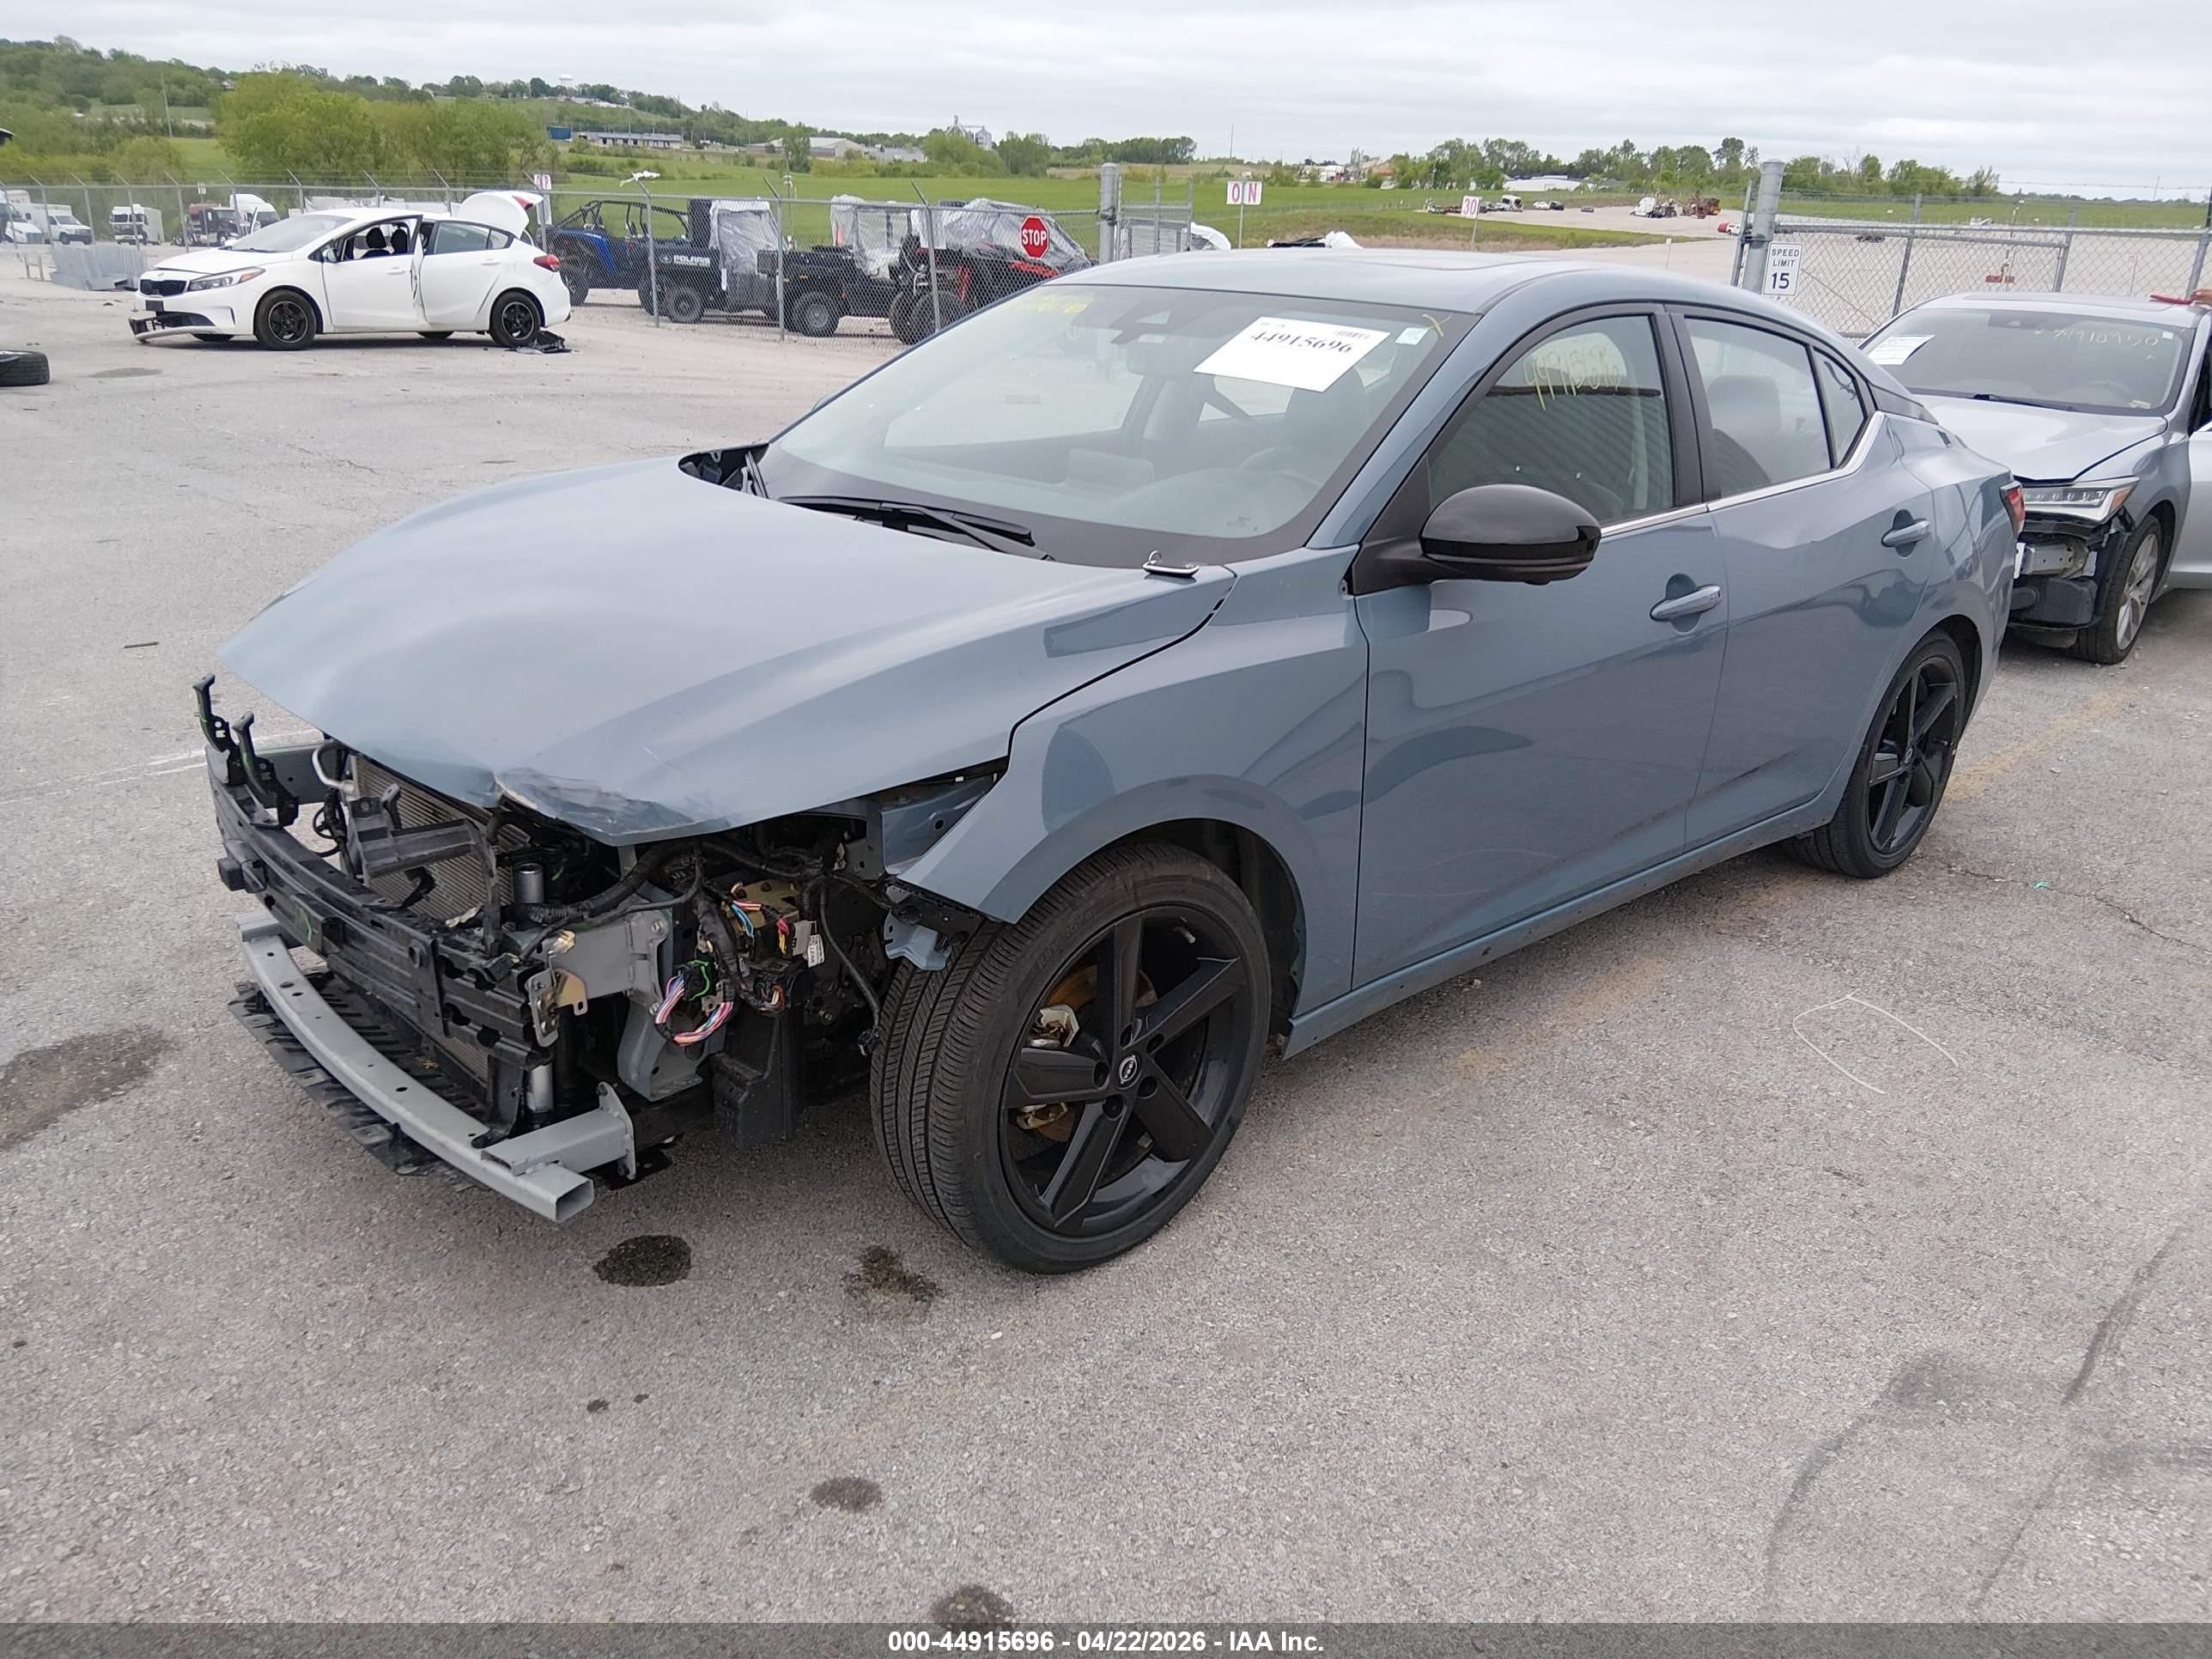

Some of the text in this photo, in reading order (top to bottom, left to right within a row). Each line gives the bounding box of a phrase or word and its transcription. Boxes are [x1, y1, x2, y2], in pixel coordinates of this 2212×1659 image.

[1022, 228, 1047, 246] STOP
[1771, 272, 1790, 289] 15
[1251, 331, 1352, 354] 44915696
